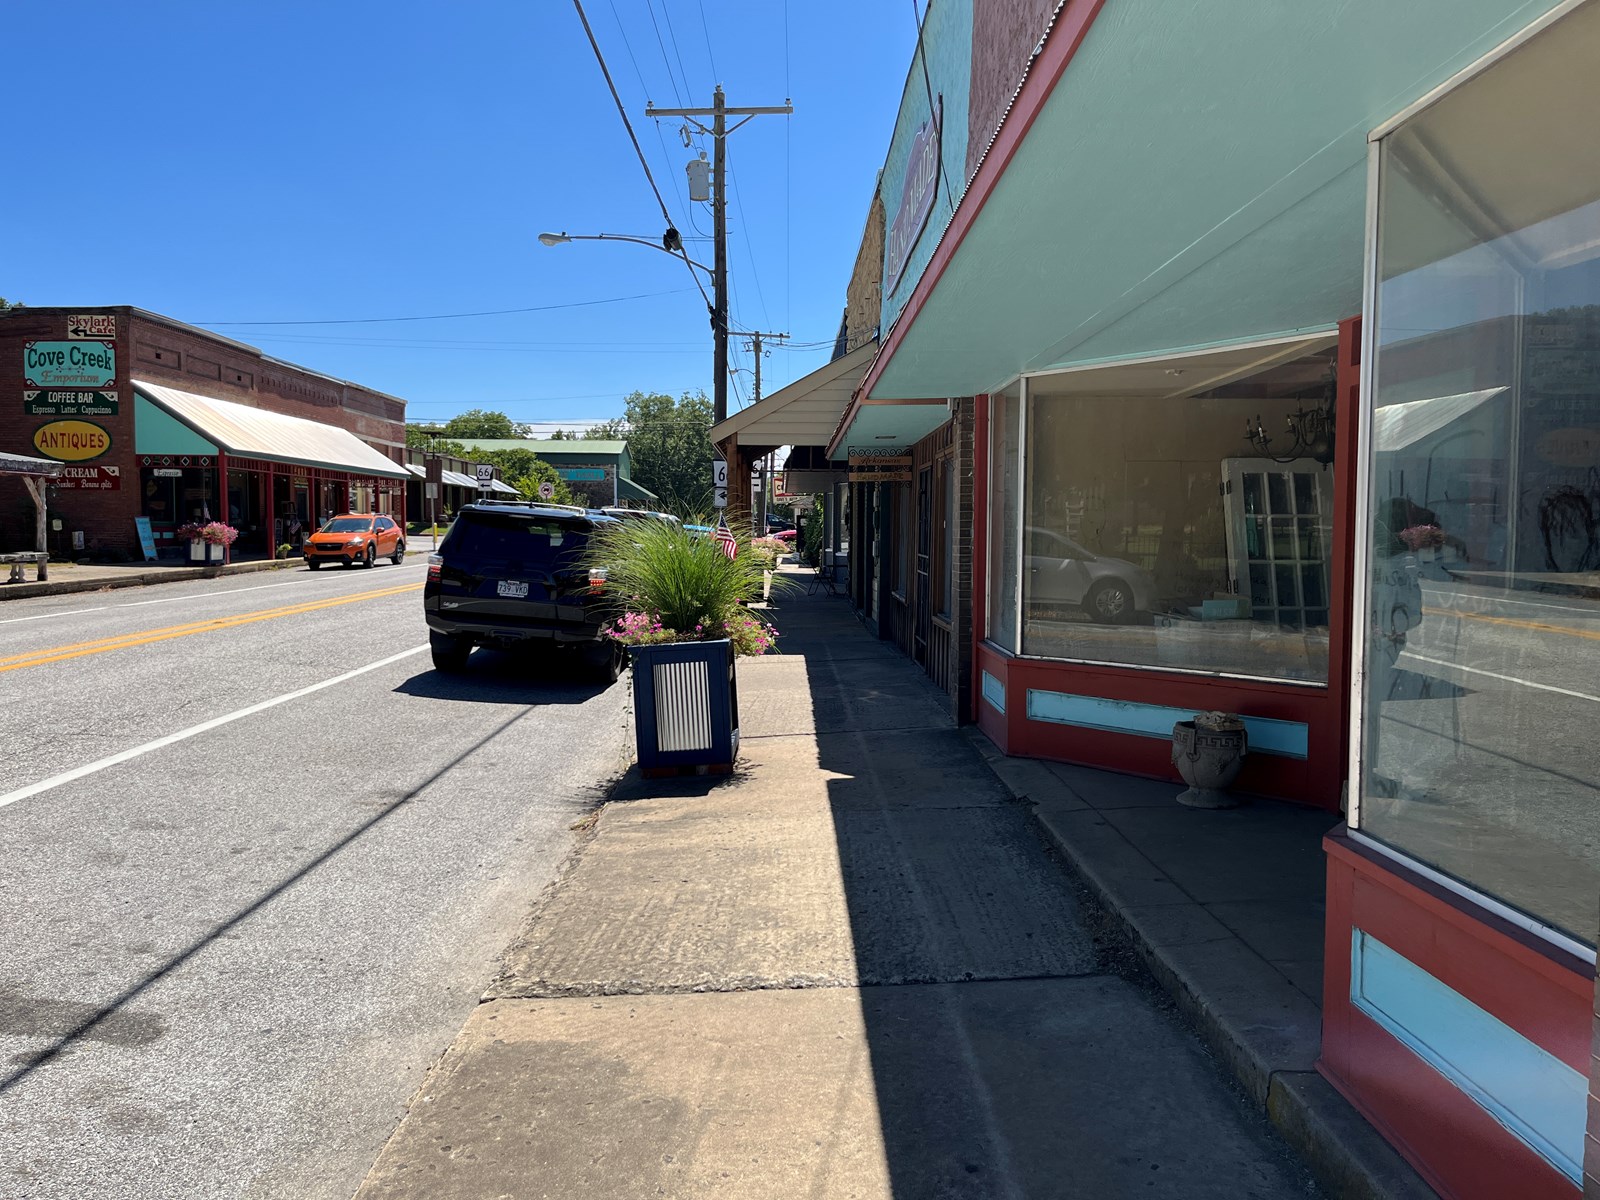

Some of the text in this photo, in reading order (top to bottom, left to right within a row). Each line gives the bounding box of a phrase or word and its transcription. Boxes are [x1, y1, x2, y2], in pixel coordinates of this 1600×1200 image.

[68, 315, 115, 329] Skylark
[89, 326, 115, 334] Cafe
[28, 346, 112, 371] Cove Creek
[41, 370, 99, 384] Emporium
[48, 391, 94, 404] COFFEE BAR
[32, 404, 56, 415] Espresso
[40, 430, 105, 450] ANTIQUES
[64, 467, 98, 478] CREAM
[478, 467, 490, 477] 66
[718, 466, 726, 482] 6
[499, 584, 511, 594] 739
